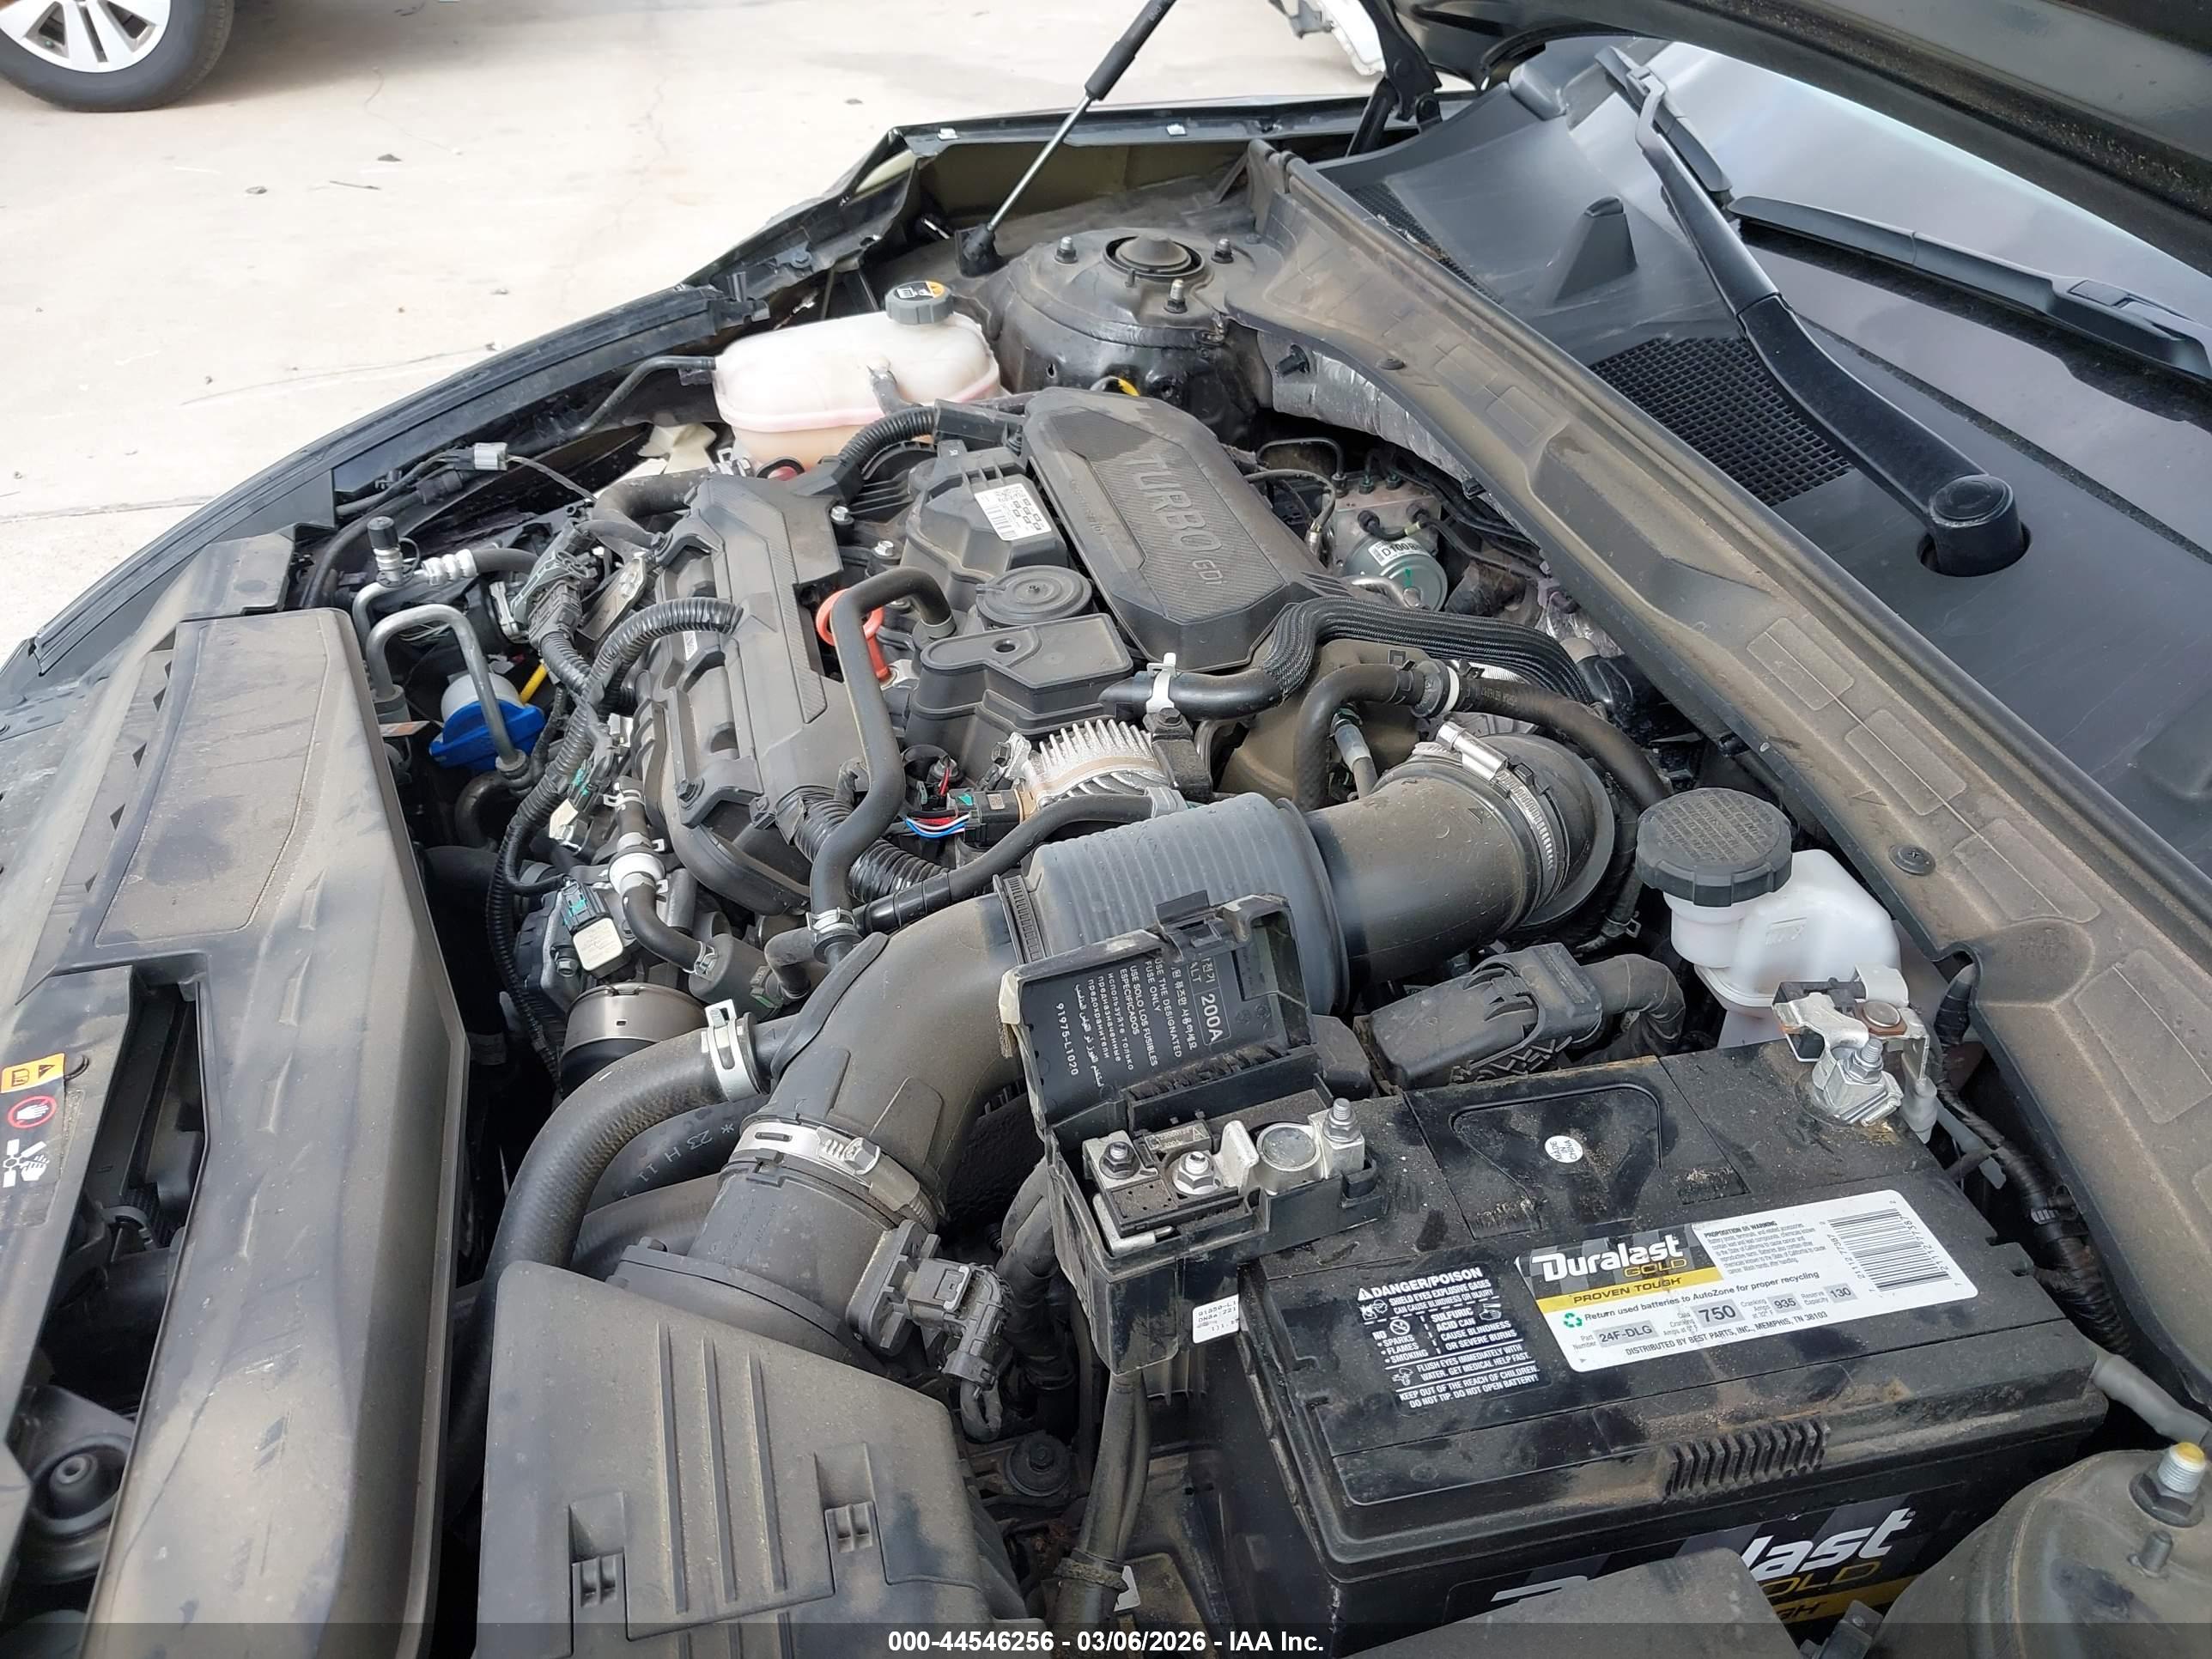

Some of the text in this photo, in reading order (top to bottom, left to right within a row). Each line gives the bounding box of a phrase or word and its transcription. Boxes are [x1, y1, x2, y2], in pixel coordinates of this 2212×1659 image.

[1125, 453, 1223, 552] TURBO
[1145, 960, 1161, 1011] FUSE ONLY
[1158, 977, 1168, 996] THE
[1120, 968, 1139, 1035] ESPECIFICADOS
[1129, 964, 1158, 1066] USE SOLO LOS FUSIBLES
[1162, 999, 1182, 1057] DESIGNATED
[1200, 994, 1223, 1042] 200A
[1056, 1002, 1079, 1075] 91975-L1020
[687, 1128, 713, 1150] 23
[1550, 1140, 1563, 1160] MADE
[1564, 1139, 1578, 1160] CHINA
[664, 1146, 682, 1163] H
[1532, 1235, 1681, 1280] Duralast
[1621, 1258, 1686, 1277] GOLD
[1371, 1267, 1482, 1297] DANGER/POISON
[1389, 1279, 1491, 1306] SHIELD EYES EXPLOSIVE GASES
[1573, 1277, 1680, 1304] PROVEN TOUGH
[1830, 1287, 1851, 1297] 130
[1393, 1288, 1493, 1315] CAN CAUSE BLINDNESS OR INJURY
[1583, 1310, 1615, 1320] Return
[1617, 1304, 1638, 1315] used
[1640, 1297, 1680, 1310] batteries
[1692, 1287, 1735, 1300] AutoZone
[1750, 1279, 1778, 1290] proper
[1780, 1272, 1820, 1283] recycling
[1773, 1297, 1796, 1309] 935
[1431, 1307, 1473, 1322] SULFURIC
[1436, 1317, 1475, 1331] ACID CAN
[1698, 1304, 1735, 1322] 750
[1371, 1330, 1387, 1340] NO
[1382, 1334, 1414, 1346] SPARKS
[1440, 1320, 1510, 1340] CAUSE BLINDNESS
[1444, 1328, 1516, 1350] OR SEVERE BURNS
[1599, 1325, 1652, 1342] 24F-DLG
[1625, 1340, 1675, 1355] DISTRIBUTED
[1687, 1334, 1707, 1343] BEST
[1708, 1328, 1736, 1339] PARTS,
[1735, 1325, 1755, 1334] INC.,
[1753, 1317, 1793, 1329] MEMPHIS,
[1803, 1310, 1827, 1321] 38103
[1386, 1341, 1419, 1354] FLAMES
[1389, 1349, 1428, 1363] SMOKING
[1416, 1343, 1522, 1372] FLUSH EYES IMMEDIATELY WITH
[1419, 1351, 1531, 1381] WATER. GET MEDICAL HELP FAST.
[1399, 1364, 1539, 1401] KEEP OUT OF THE REACH OF CHILDREN.
[1408, 1399, 1422, 1407] DO
[1421, 1395, 1437, 1405] NOT
[1452, 1389, 1466, 1398] DO
[1465, 1386, 1481, 1395] NOT
[1481, 1381, 1503, 1392] OPEN
[1502, 1373, 1538, 1388] BATTERY!
[1761, 1561, 1881, 1598] OLD
